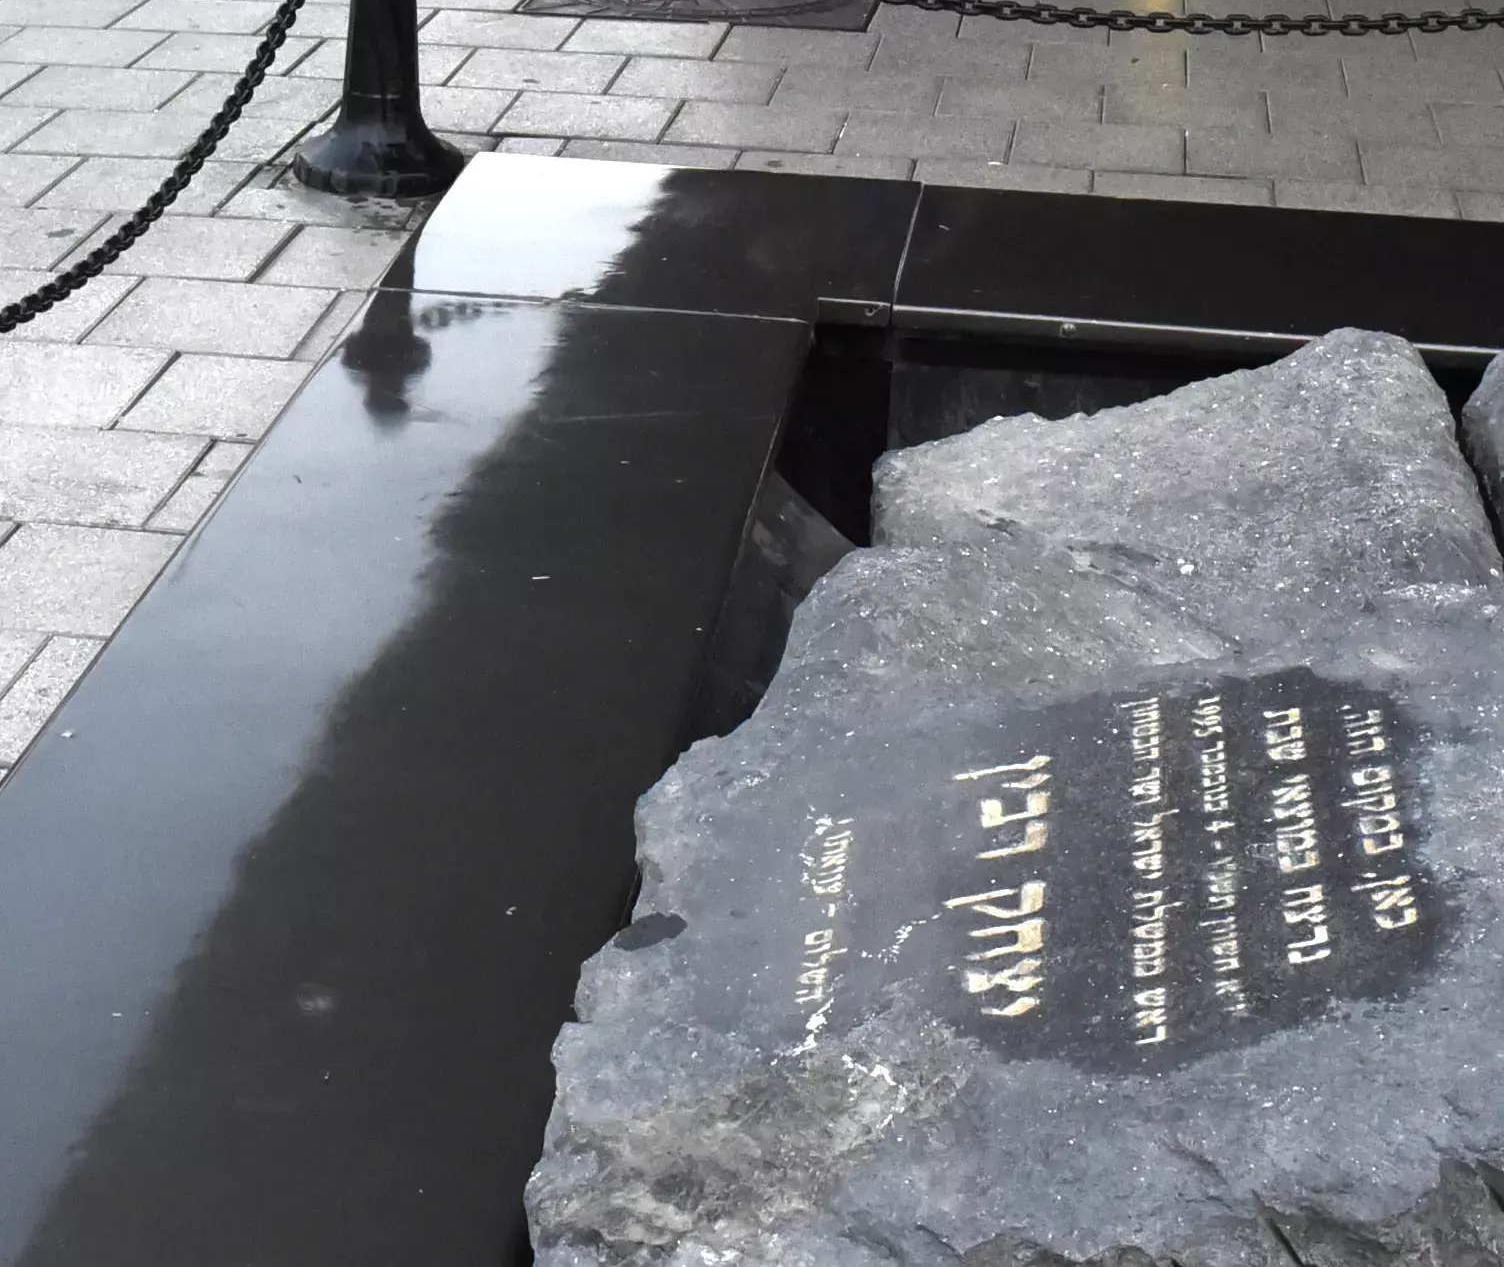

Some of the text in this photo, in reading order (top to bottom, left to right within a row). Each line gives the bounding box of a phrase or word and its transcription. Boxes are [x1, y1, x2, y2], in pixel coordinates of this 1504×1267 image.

[1189, 695, 1223, 738] 1995
[1127, 768, 1162, 805] ושר
[1198, 740, 1228, 813] בנובמבר
[1339, 765, 1403, 855] במקום
[1131, 808, 1178, 879] ישראל
[1208, 819, 1234, 832] 4
[1262, 707, 1330, 965] נרצח במוצאי שבת
[940, 754, 1052, 1018] יצחק רבין
[1350, 872, 1418, 930] כאן,
[792, 928, 848, 1004] השלום
[1130, 890, 1182, 977] ממשלת
[1132, 986, 1167, 1046] ראש
